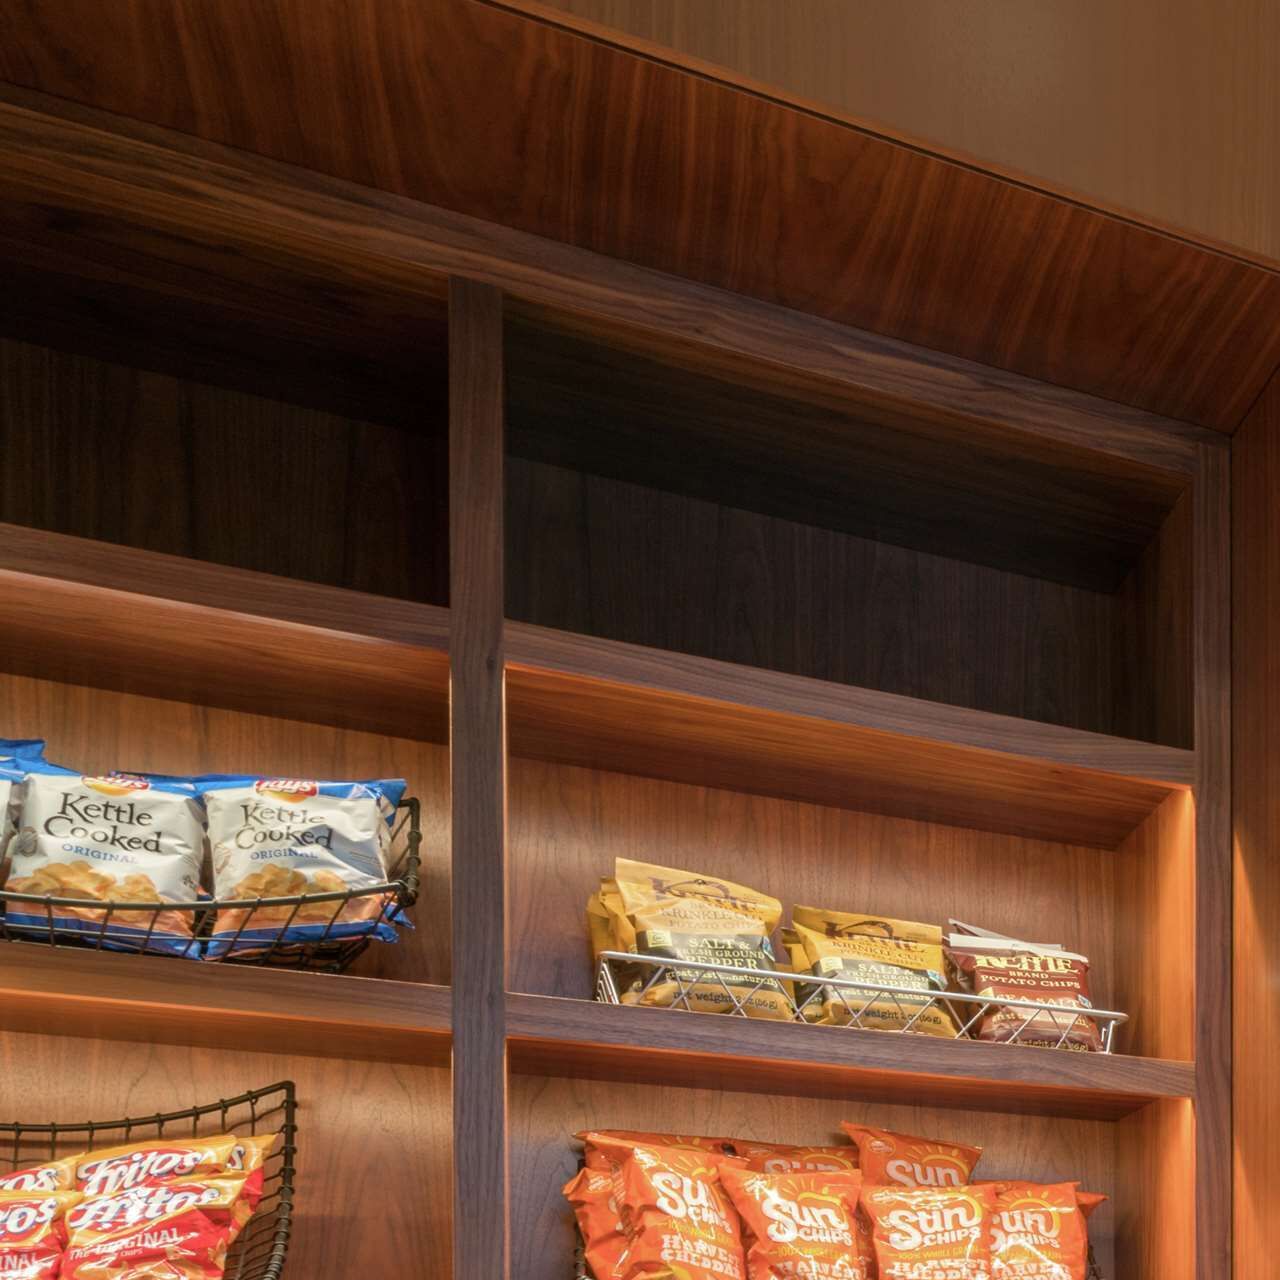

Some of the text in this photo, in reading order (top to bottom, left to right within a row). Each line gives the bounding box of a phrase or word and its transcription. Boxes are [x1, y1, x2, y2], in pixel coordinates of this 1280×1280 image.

[57, 792, 153, 826] Kettle
[240, 802, 326, 827] Kettle
[43, 815, 162, 853] Cooked
[234, 825, 334, 850] Cooked
[62, 843, 140, 865] ORIGINAL
[250, 848, 320, 861] ORIGINAL
[688, 936, 735, 950] SALT
[714, 949, 766, 961] GROUND
[858, 962, 901, 975] SALT
[1008, 970, 1049, 979] BRAND
[980, 974, 1082, 990] POTATO CHIPS
[77, 1149, 214, 1196] Fritos
[885, 1159, 961, 1187] Sun
[69, 1185, 222, 1230] Fritos
[761, 1198, 849, 1243] Sun
[887, 1202, 982, 1251] Sun
[799, 1226, 853, 1247] CHIPS
[923, 1225, 982, 1247] CHIPS
